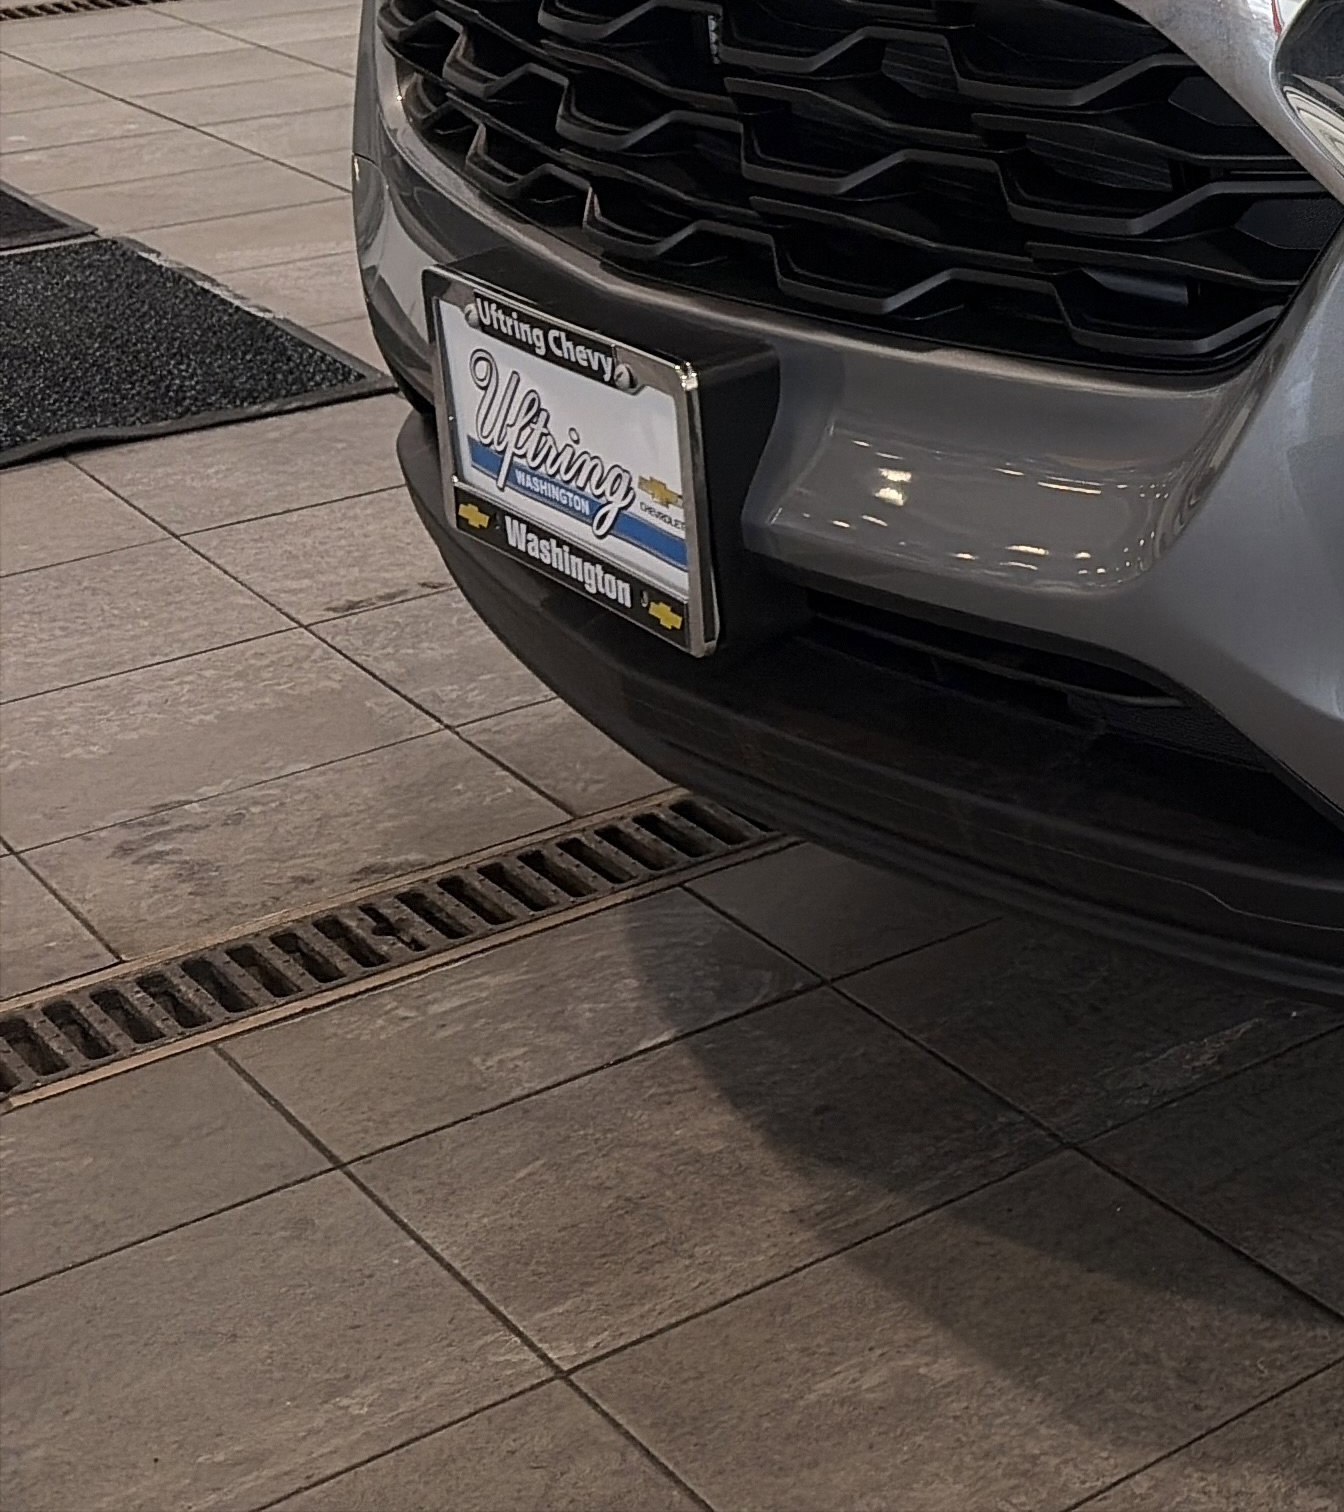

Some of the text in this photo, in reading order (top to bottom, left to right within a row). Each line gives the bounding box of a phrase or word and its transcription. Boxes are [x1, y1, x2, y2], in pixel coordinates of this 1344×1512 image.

[475, 296, 613, 381] Uftring Chevy
[469, 348, 636, 538] Uftring
[515, 469, 591, 516] WASHINGTON
[504, 515, 632, 609] Washington
